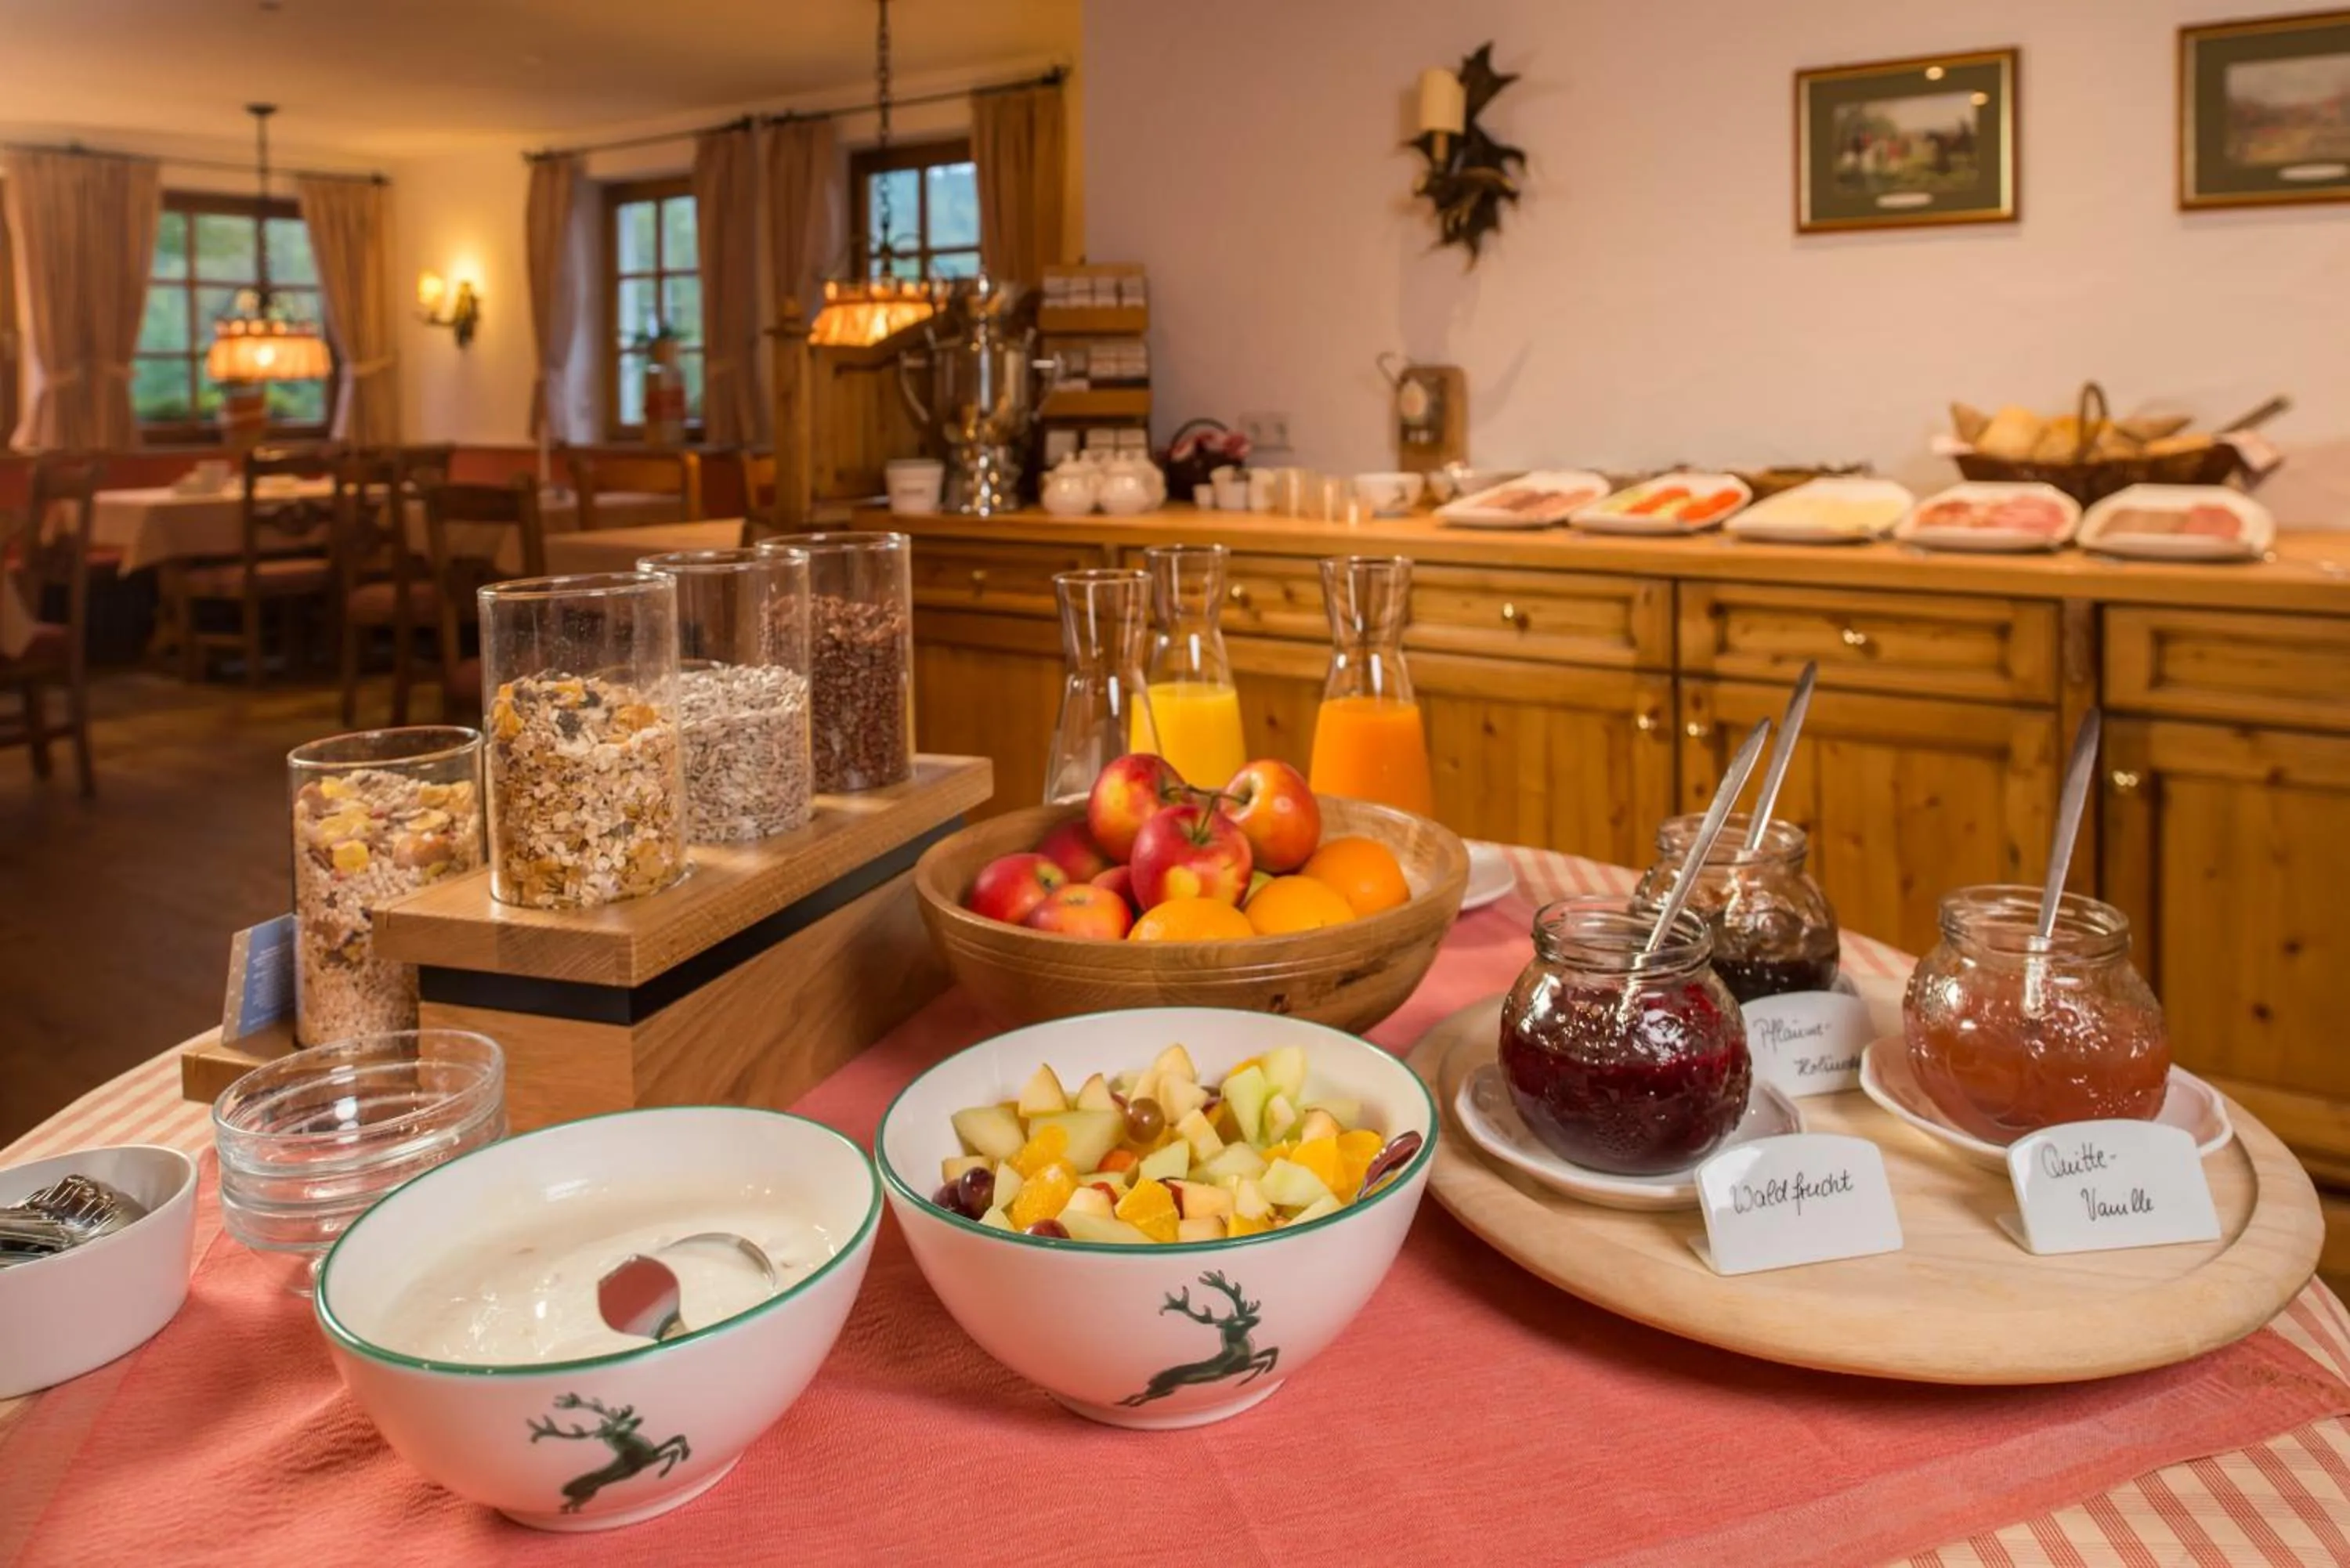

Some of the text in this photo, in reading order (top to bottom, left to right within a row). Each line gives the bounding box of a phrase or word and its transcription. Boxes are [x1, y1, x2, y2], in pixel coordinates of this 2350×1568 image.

[2041, 1142, 2117, 1178] Quitte-
[1729, 1169, 1854, 1216] Waldfrucht
[2081, 1187, 2154, 1222] Vanille
